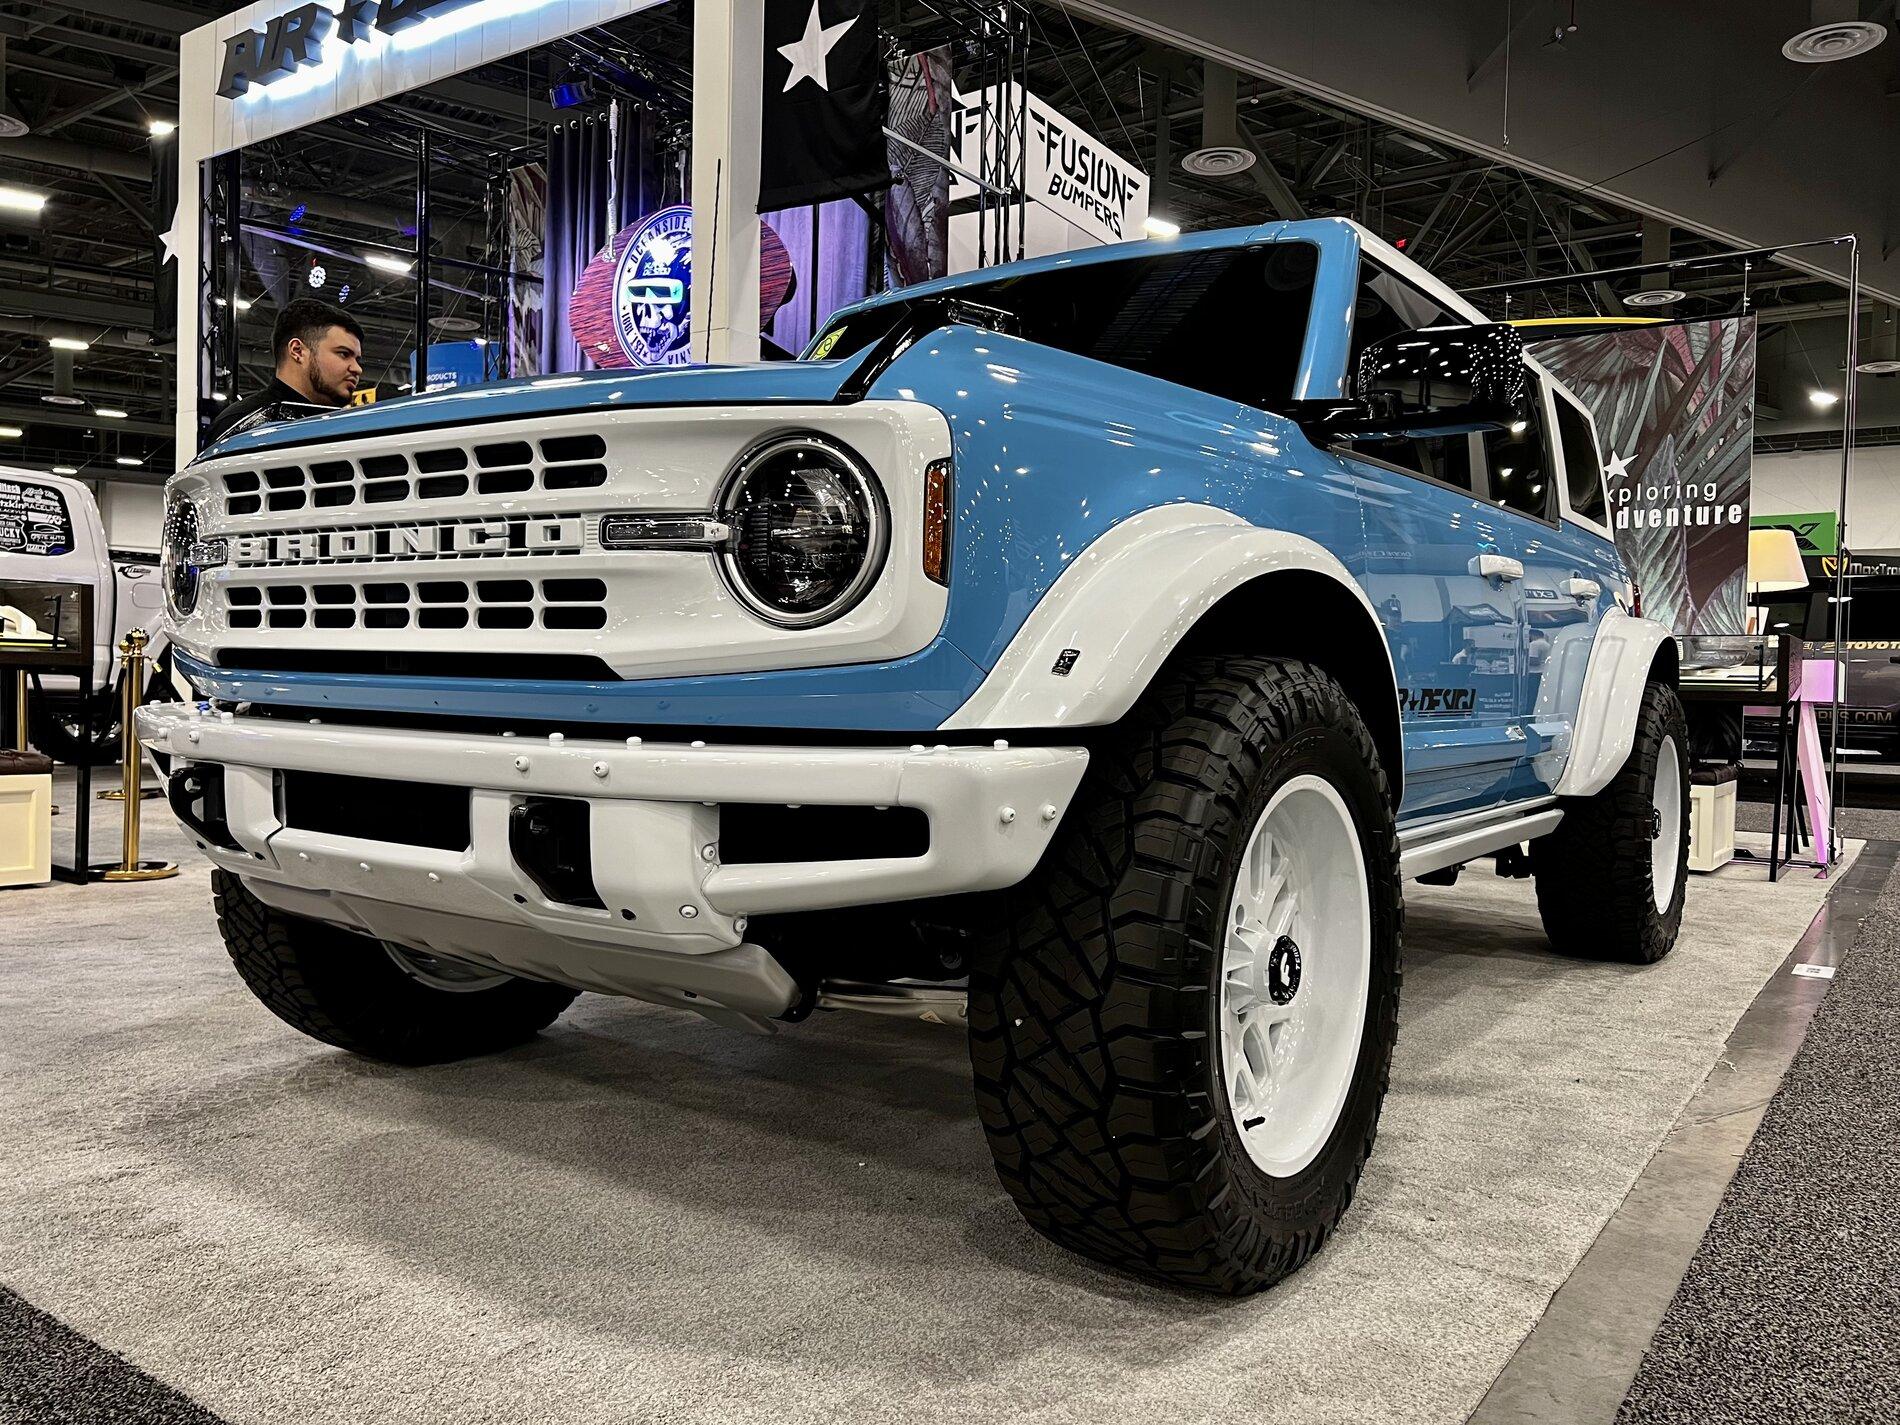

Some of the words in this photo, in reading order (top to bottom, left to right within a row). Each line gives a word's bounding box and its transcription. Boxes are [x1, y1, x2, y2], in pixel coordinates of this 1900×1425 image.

[216, 2, 333, 99] AIR
[1030, 108, 1140, 222] FUSION
[1048, 173, 1122, 240] BUMPERS
[1608, 480, 1717, 506] xploring
[1616, 503, 1742, 529] dventure
[232, 519, 585, 563] BRONCO
[1850, 562, 1900, 576] MaxTra
[1846, 641, 1900, 651] TOYOT
